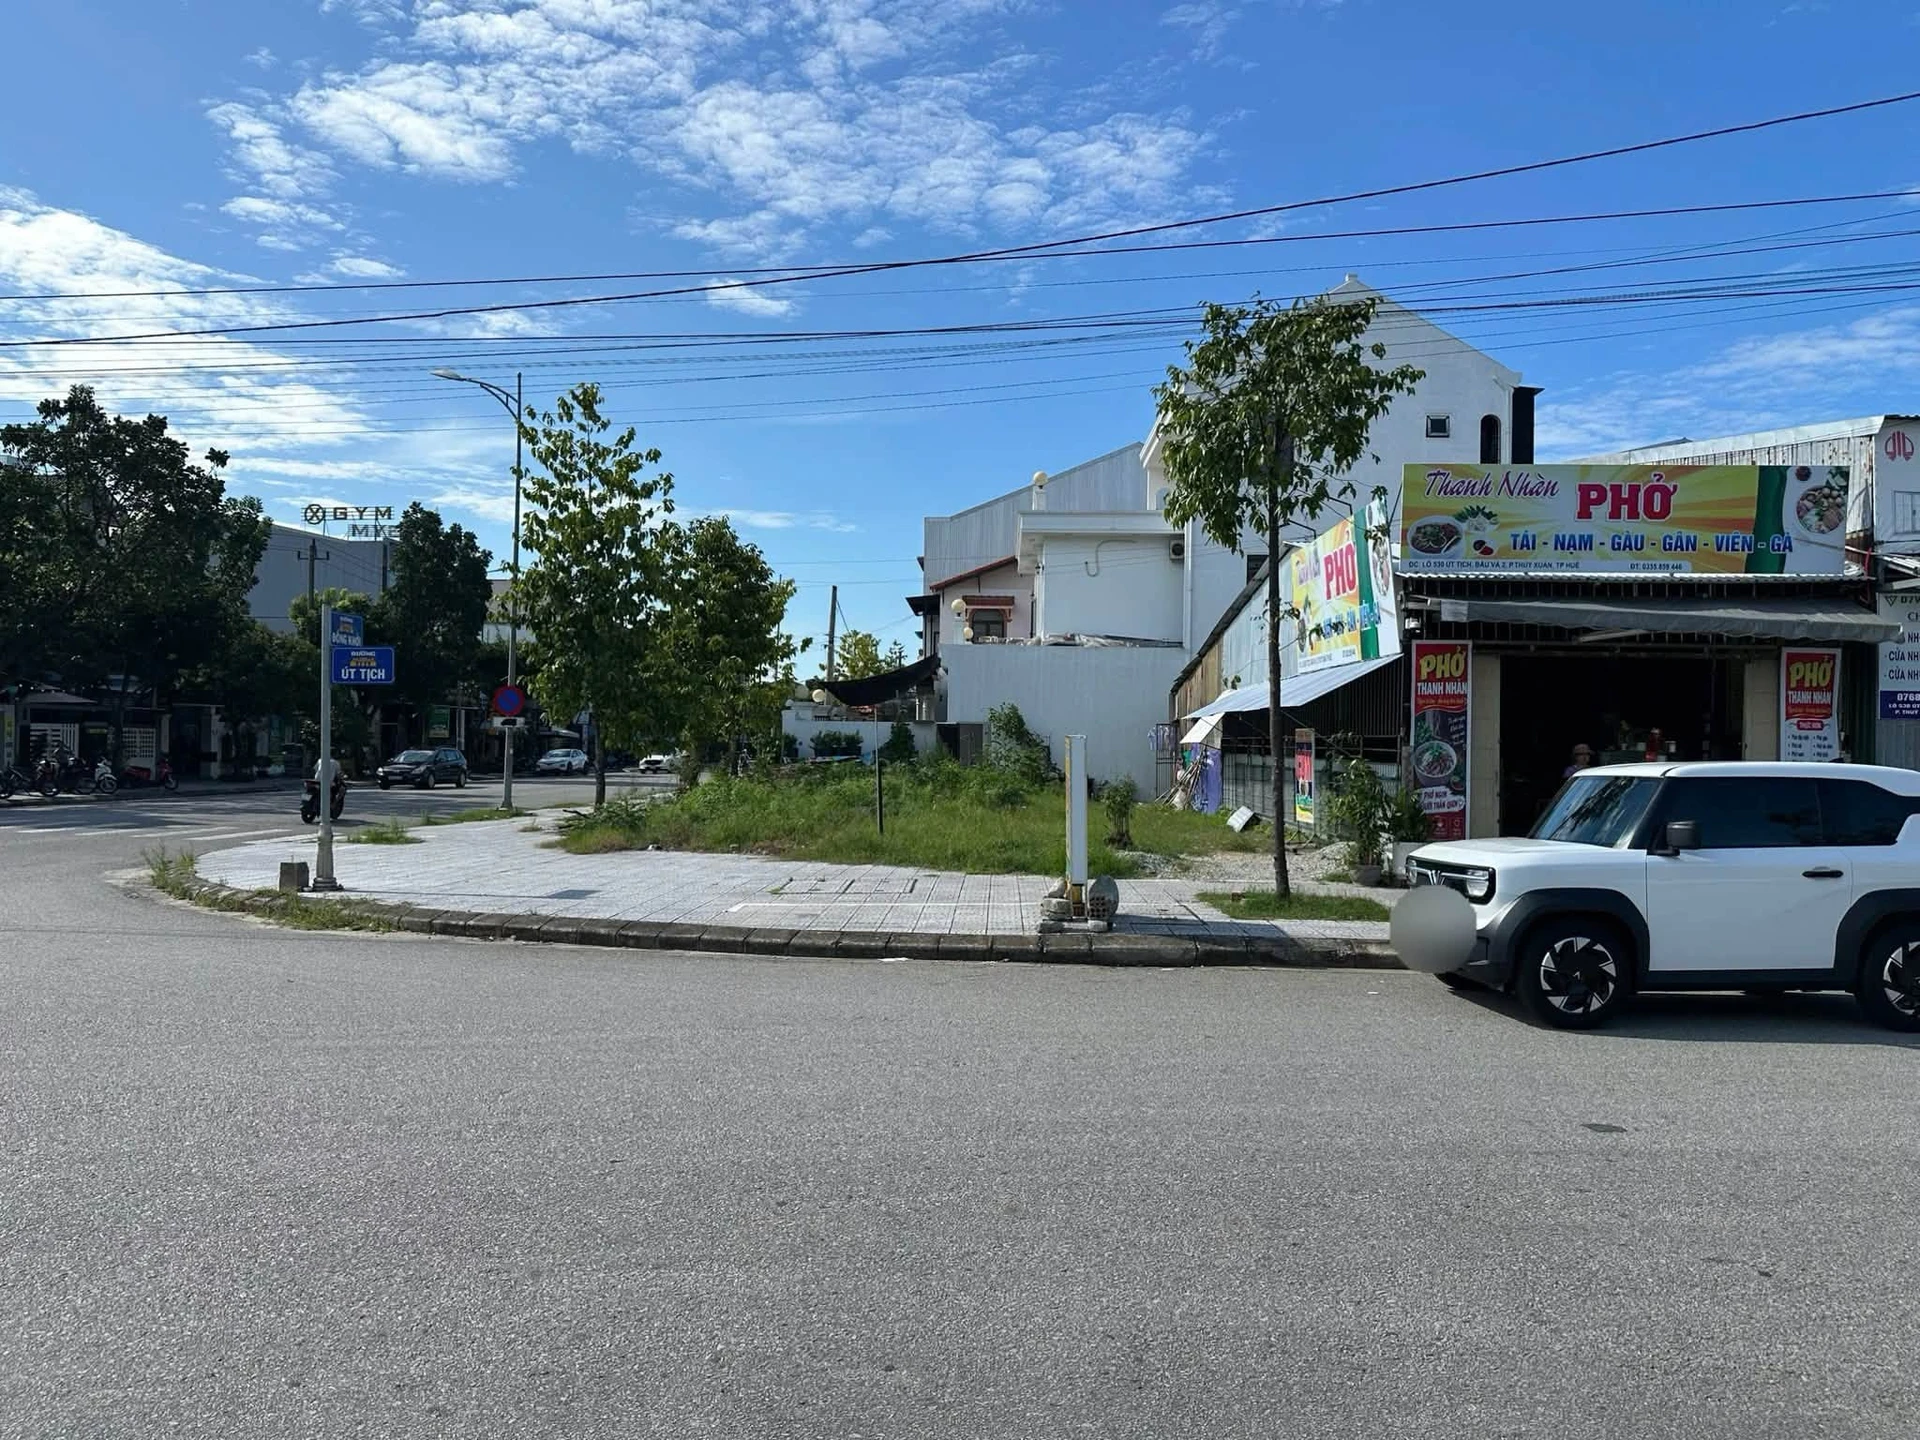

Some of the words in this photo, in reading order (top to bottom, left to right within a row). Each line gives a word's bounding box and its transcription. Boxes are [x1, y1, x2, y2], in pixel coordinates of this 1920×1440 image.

[1425, 470, 1493, 496] Thanh
[1498, 471, 1560, 497] Nhàn
[1576, 473, 1678, 520] PHỞ
[333, 506, 392, 520] GYM
[1511, 530, 1536, 550] TÁI
[1554, 533, 1593, 554] NẠM
[1715, 531, 1753, 552] VIÊN
[1888, 647, 1906, 661] CỬA
[1419, 645, 1467, 680] PHỞ
[341, 666, 357, 679] ÚT
[359, 668, 385, 682] TỊCH
[1789, 655, 1833, 689] PHỞ
[1888, 666, 1906, 680] CỬA
[1417, 682, 1444, 695] THANH
[1788, 690, 1812, 704] THANH
